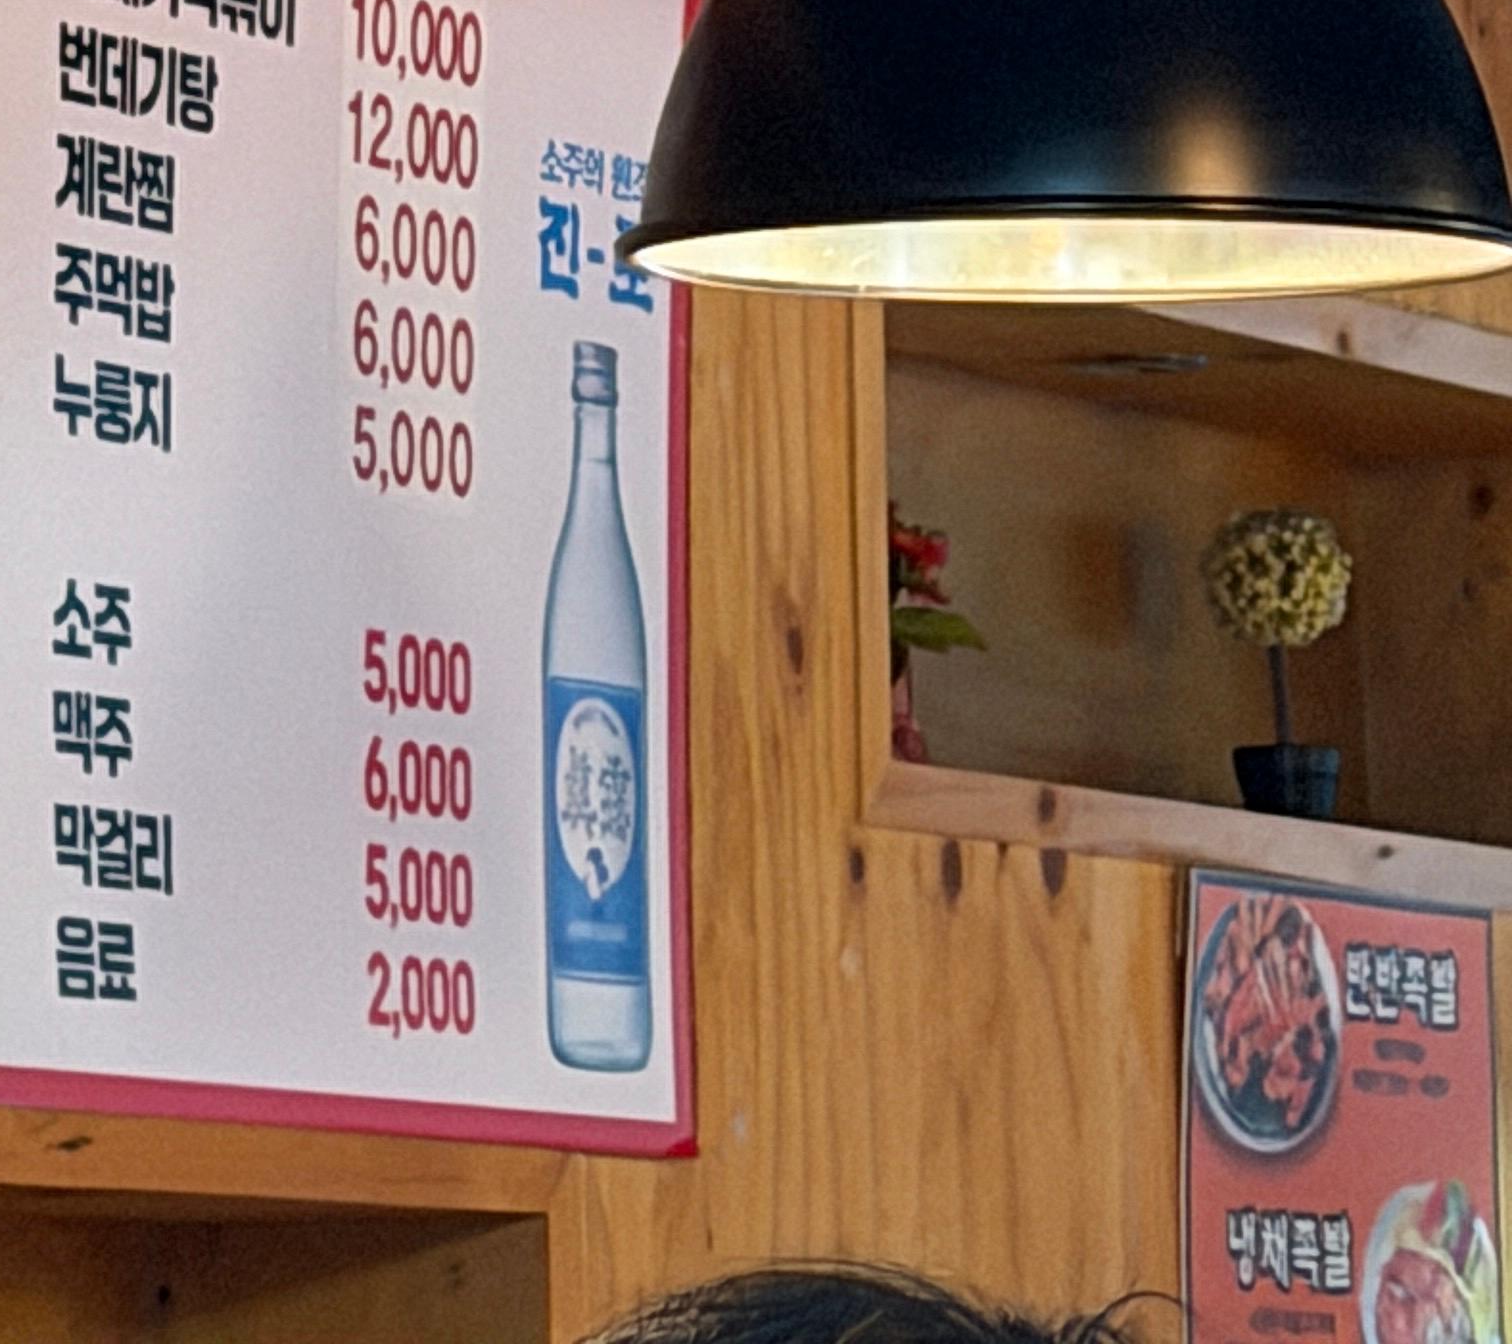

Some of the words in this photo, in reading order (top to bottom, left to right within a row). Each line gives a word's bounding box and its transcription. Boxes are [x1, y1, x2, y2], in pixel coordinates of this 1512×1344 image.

[59, 22, 218, 134] 번데기탕
[55, 134, 176, 234] 계란찜
[348, 90, 479, 190] 12,000
[540, 139, 604, 196] 소주의
[355, 196, 476, 292] 6,000
[54, 243, 174, 345] 주먹밥
[354, 300, 475, 395] 6,000
[53, 354, 171, 453] 누룽지
[352, 407, 473, 498] 5,000
[52, 578, 132, 665] 소주
[363, 629, 471, 714] 5,000
[52, 691, 133, 776] 맥주
[363, 736, 472, 822] 6,000
[54, 803, 173, 895] 막걸리
[365, 843, 472, 928] 5,000
[56, 916, 137, 1001] 음료
[367, 951, 474, 1037] 2,000
